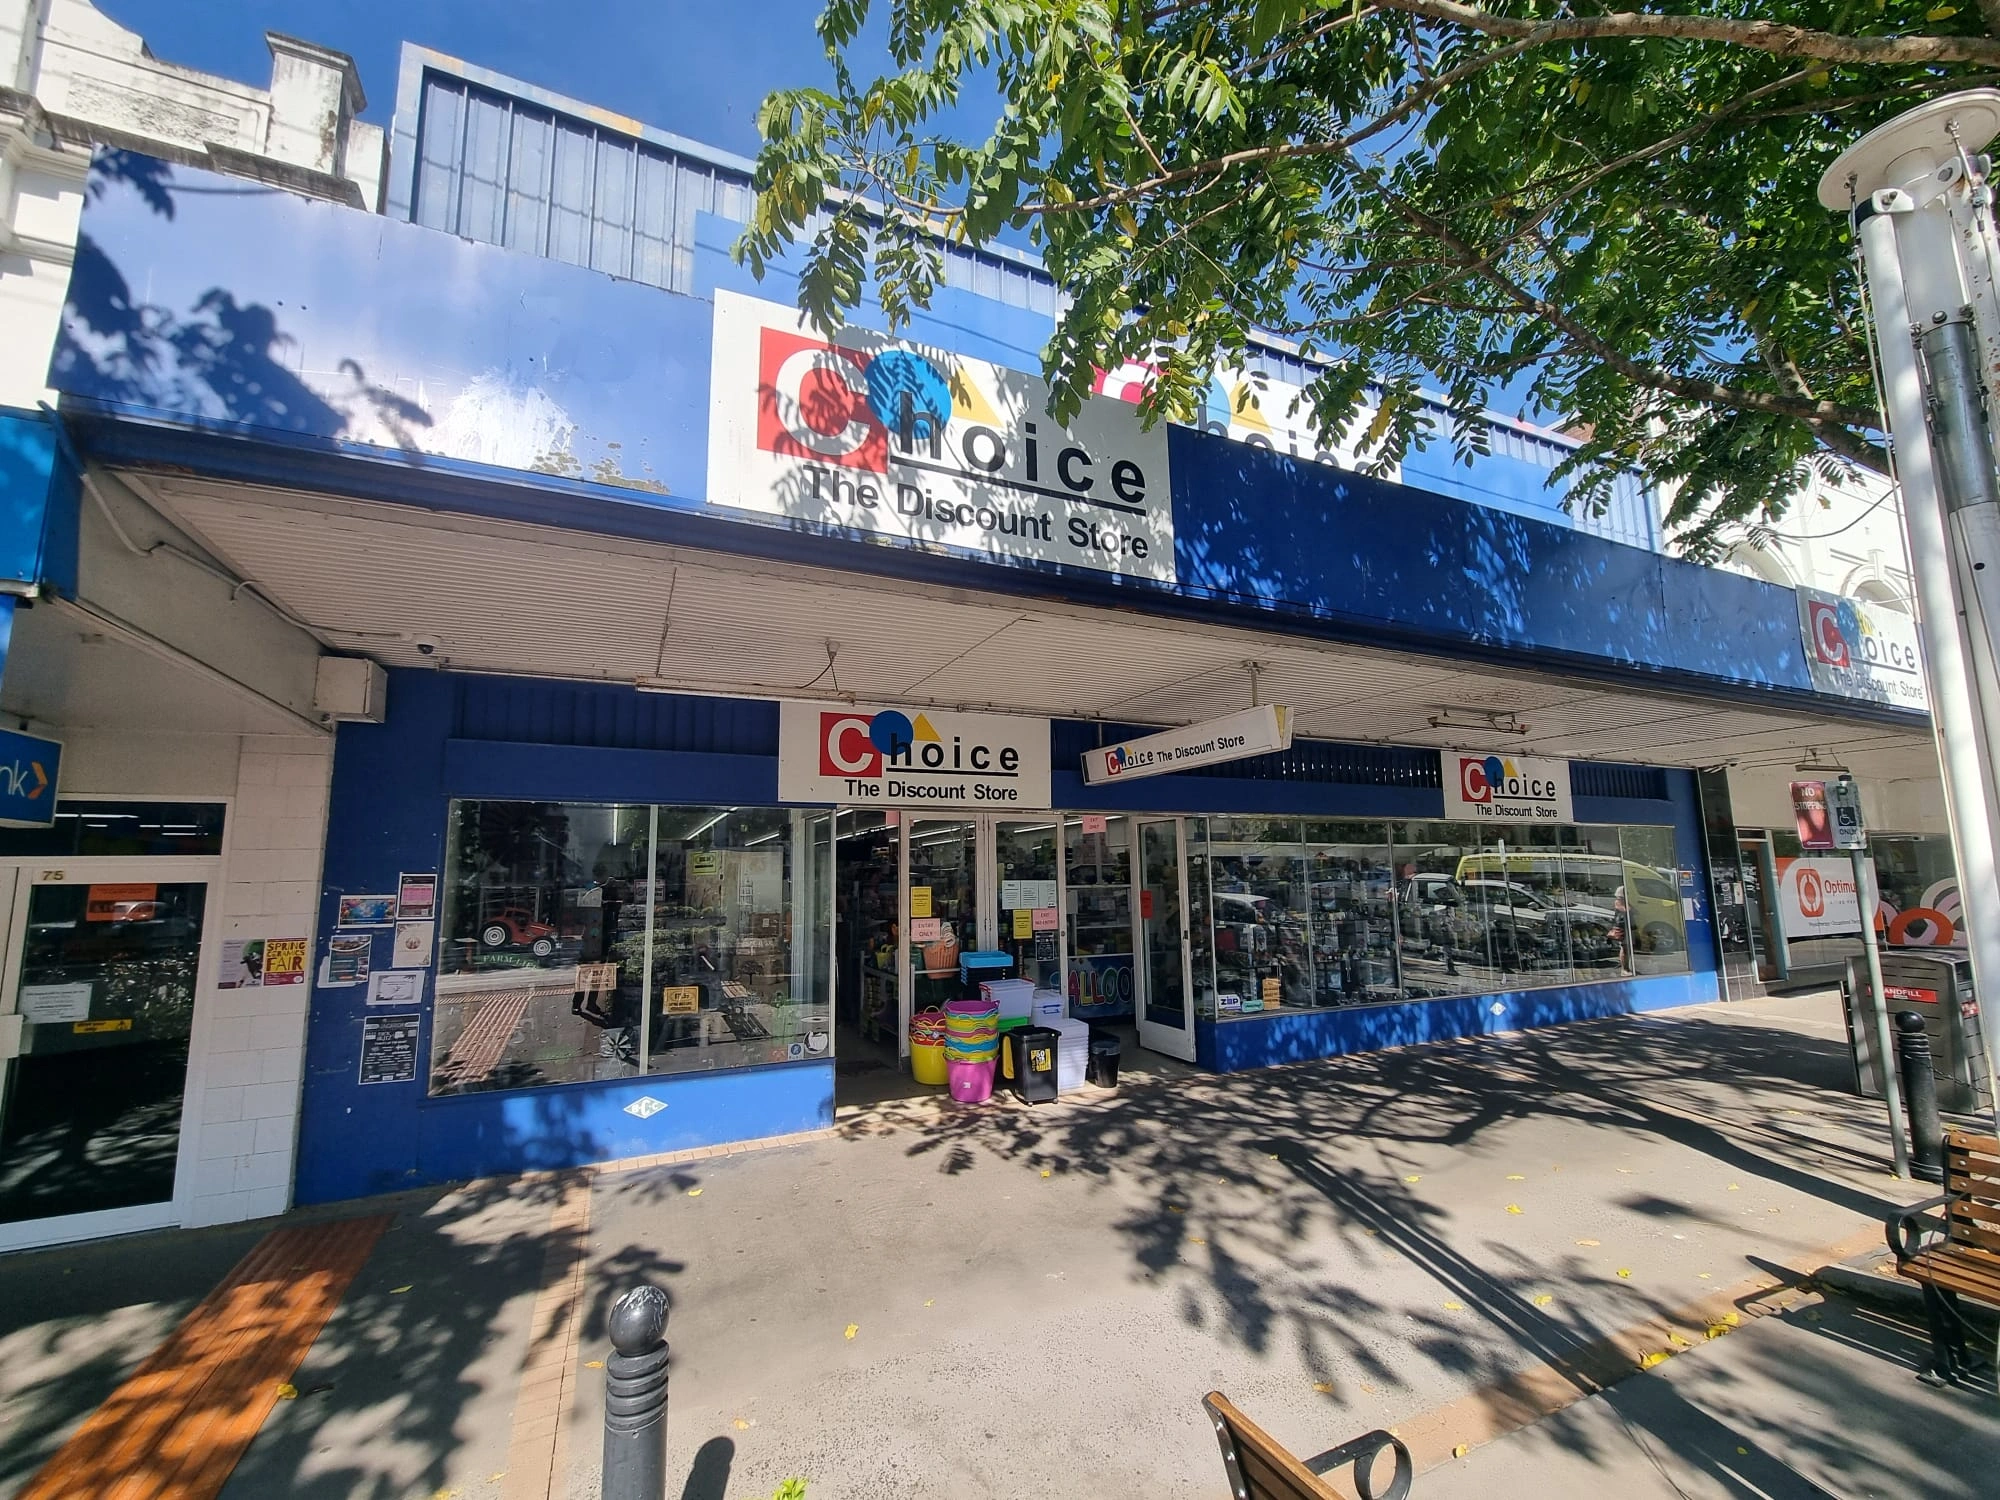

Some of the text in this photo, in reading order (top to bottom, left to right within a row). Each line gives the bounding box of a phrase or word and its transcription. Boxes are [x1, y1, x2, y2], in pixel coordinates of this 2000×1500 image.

[775, 348, 1147, 504] Choice
[802, 463, 1149, 559] The Discount Store
[1831, 667, 1924, 700] The Discount Store
[827, 718, 1020, 773] Choice
[1107, 734, 1246, 773] Choice The Discount Store
[1464, 761, 1556, 800] Choice
[844, 779, 1018, 801] The Discount Store
[1801, 786, 1815, 797] NO
[1836, 785, 1849, 802] P
[1474, 803, 1558, 818] The Discount Store
[1794, 801, 1827, 810] STOPPING
[42, 870, 65, 881] 75
[1824, 879, 1857, 896] Optimu
[266, 941, 306, 952] SPRING
[265, 956, 304, 972] FAIR
[1884, 986, 1922, 998] ANDFILL
